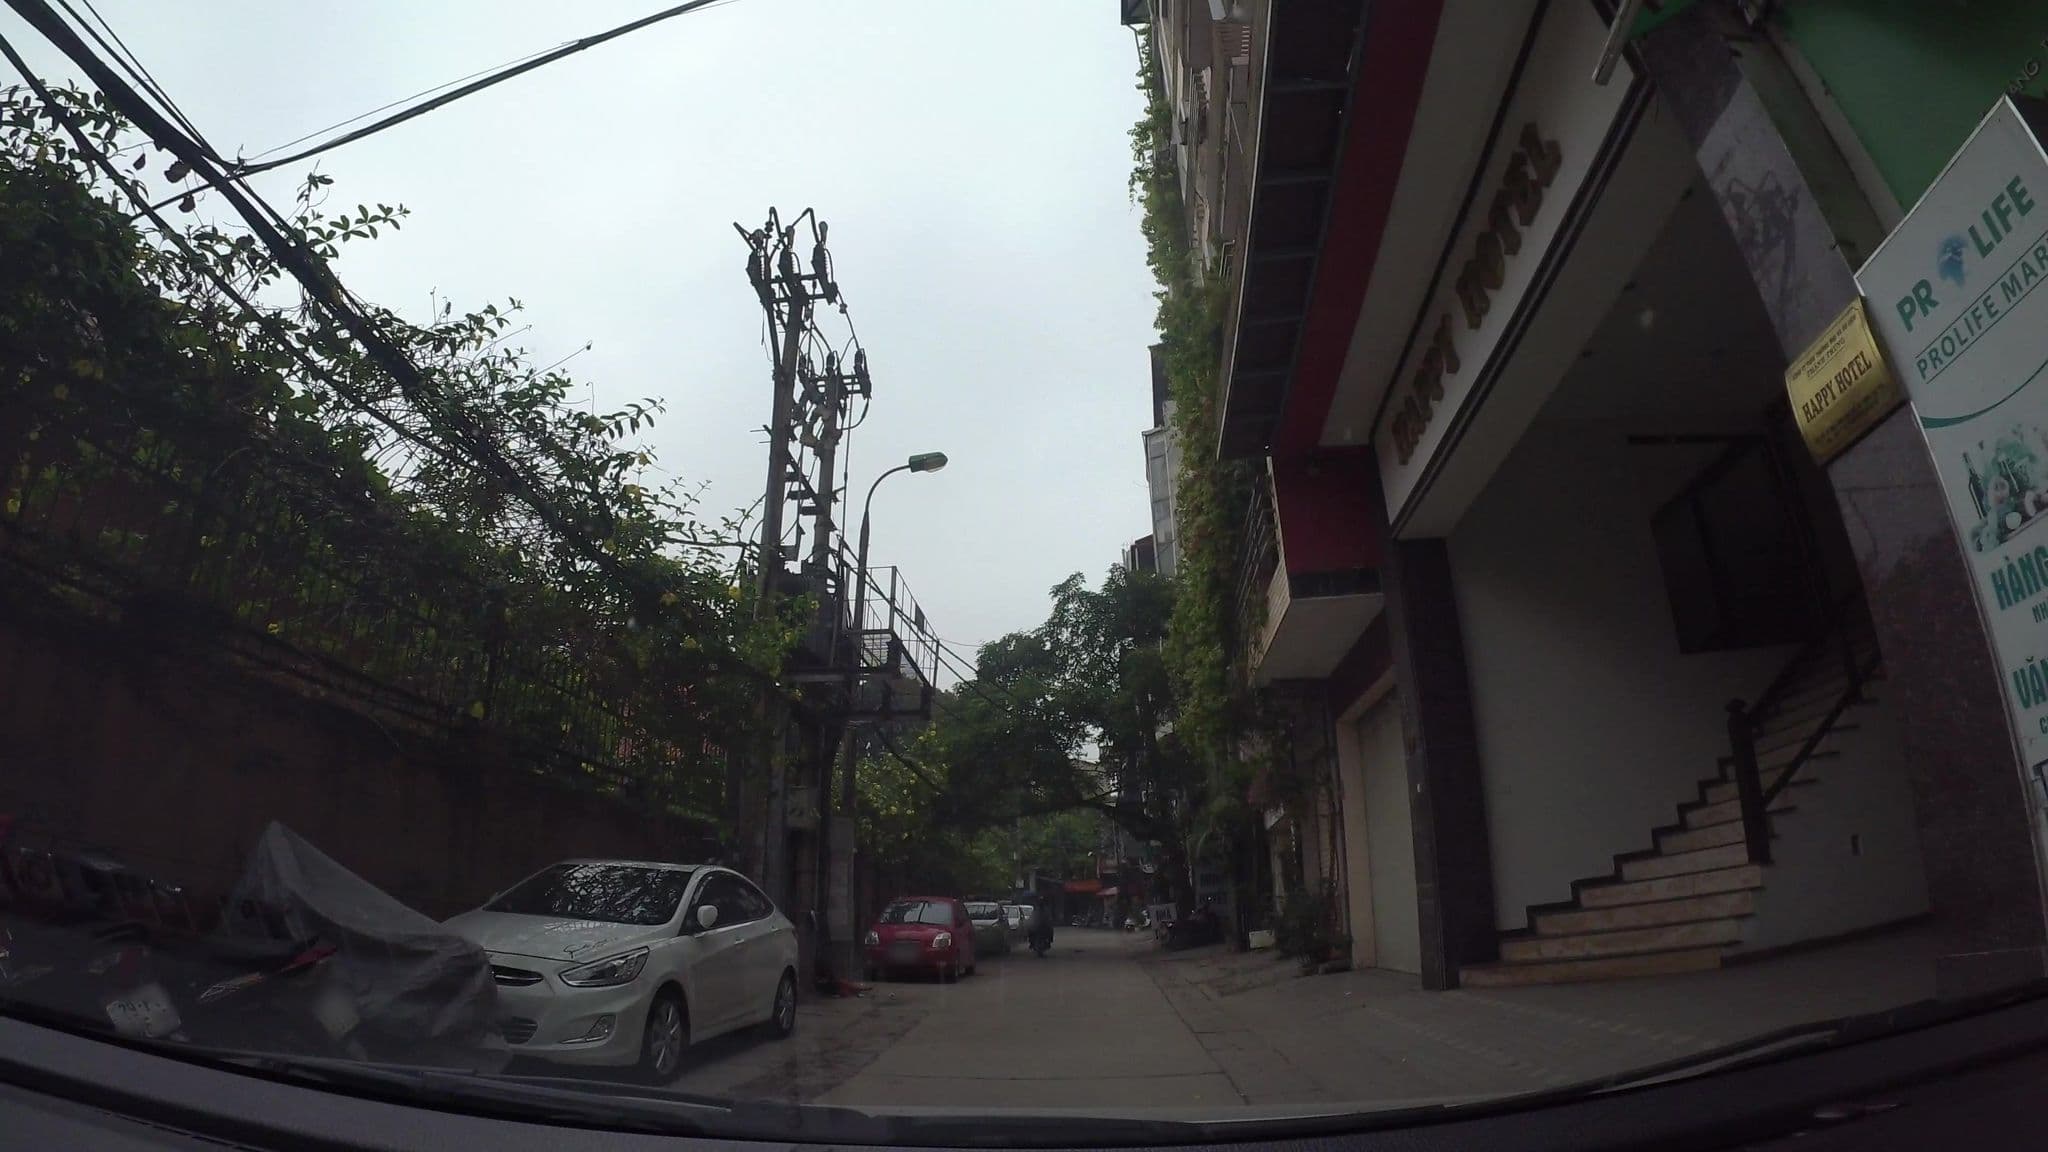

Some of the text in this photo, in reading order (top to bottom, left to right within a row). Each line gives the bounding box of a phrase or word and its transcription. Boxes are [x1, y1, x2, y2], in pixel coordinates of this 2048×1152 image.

[1392, 122, 1562, 466] HAPPY HOTEL
[1916, 237, 2048, 380] PROLIFE MAR
[1802, 379, 1837, 423] HAPPY
[1834, 350, 1873, 394] HOTEL
